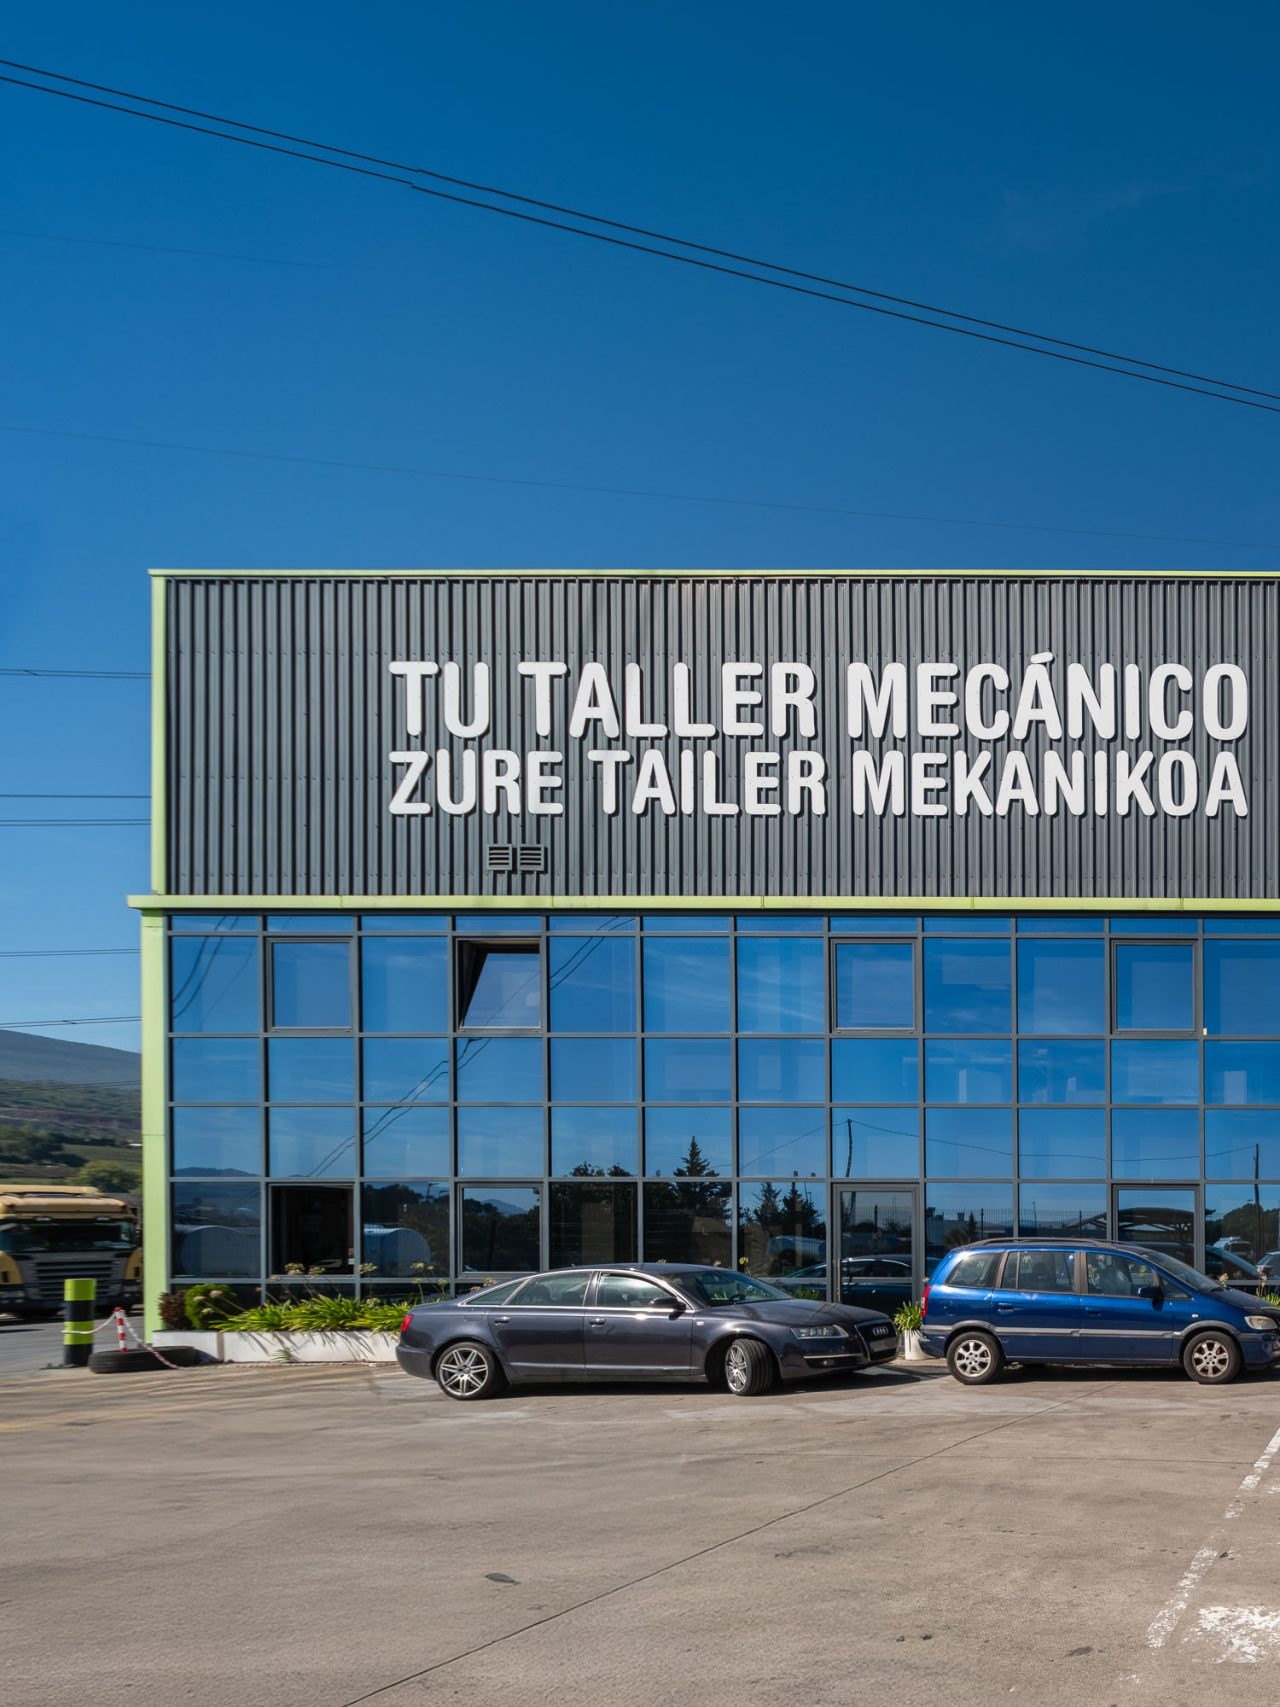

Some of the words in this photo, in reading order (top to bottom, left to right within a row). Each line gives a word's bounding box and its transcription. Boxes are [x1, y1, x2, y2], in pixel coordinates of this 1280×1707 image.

[388, 661, 490, 739] TU
[517, 661, 816, 739] TALLER
[847, 651, 1249, 741] MECÁNICO
[388, 748, 564, 816] ZURE
[589, 749, 826, 816] TAILER
[852, 749, 1249, 818] MEKANIKOA
